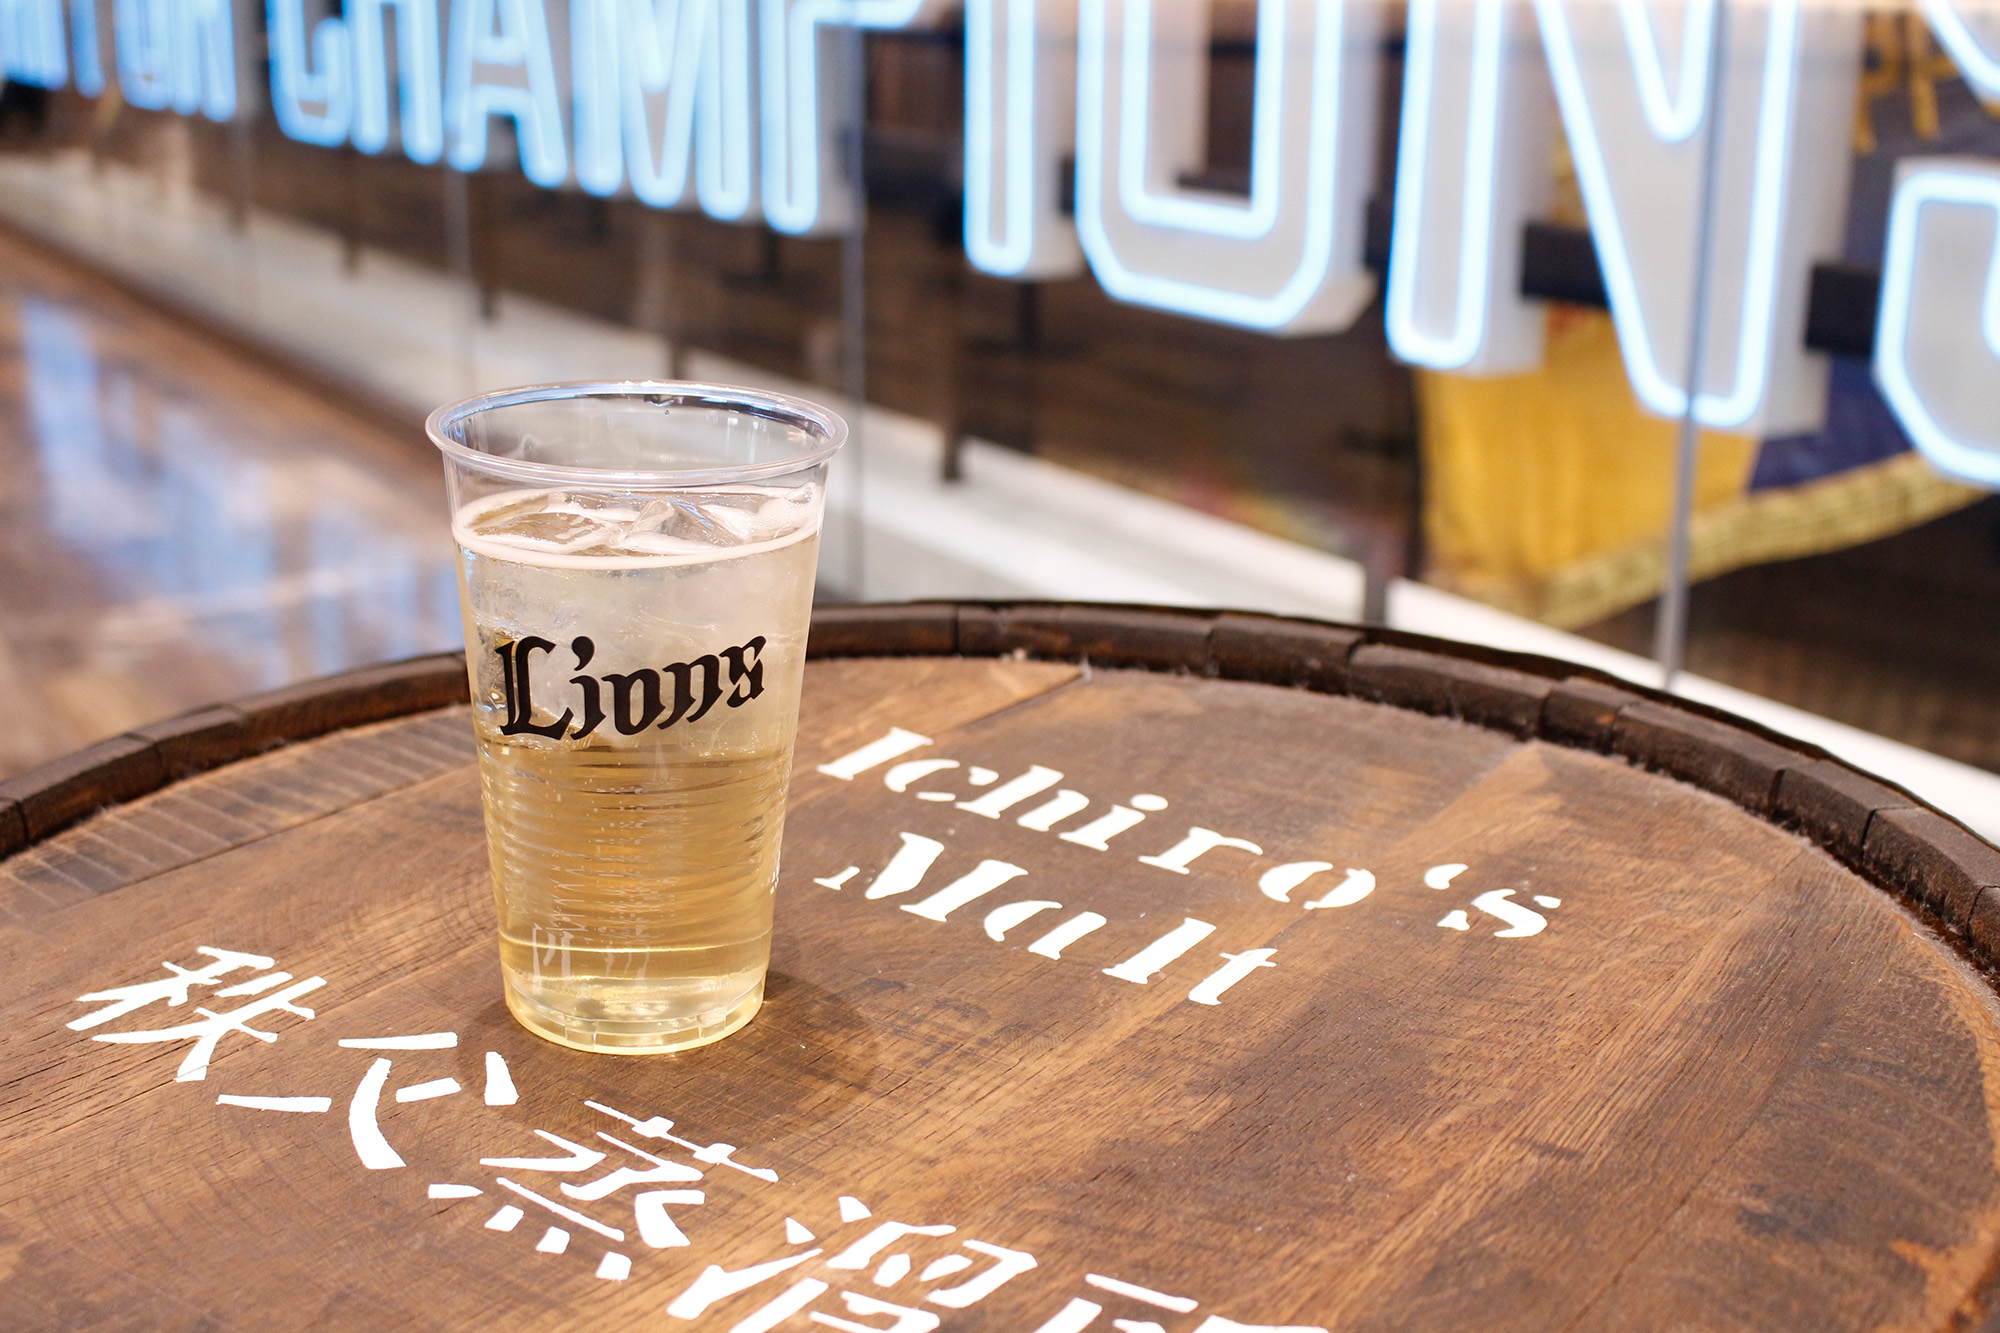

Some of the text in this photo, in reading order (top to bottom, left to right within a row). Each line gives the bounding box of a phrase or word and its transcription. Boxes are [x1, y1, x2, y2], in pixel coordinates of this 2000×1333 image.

[493, 635, 767, 742] Lions
[812, 830, 1279, 1007] Malt
[815, 726, 1562, 939] Ichiro's
